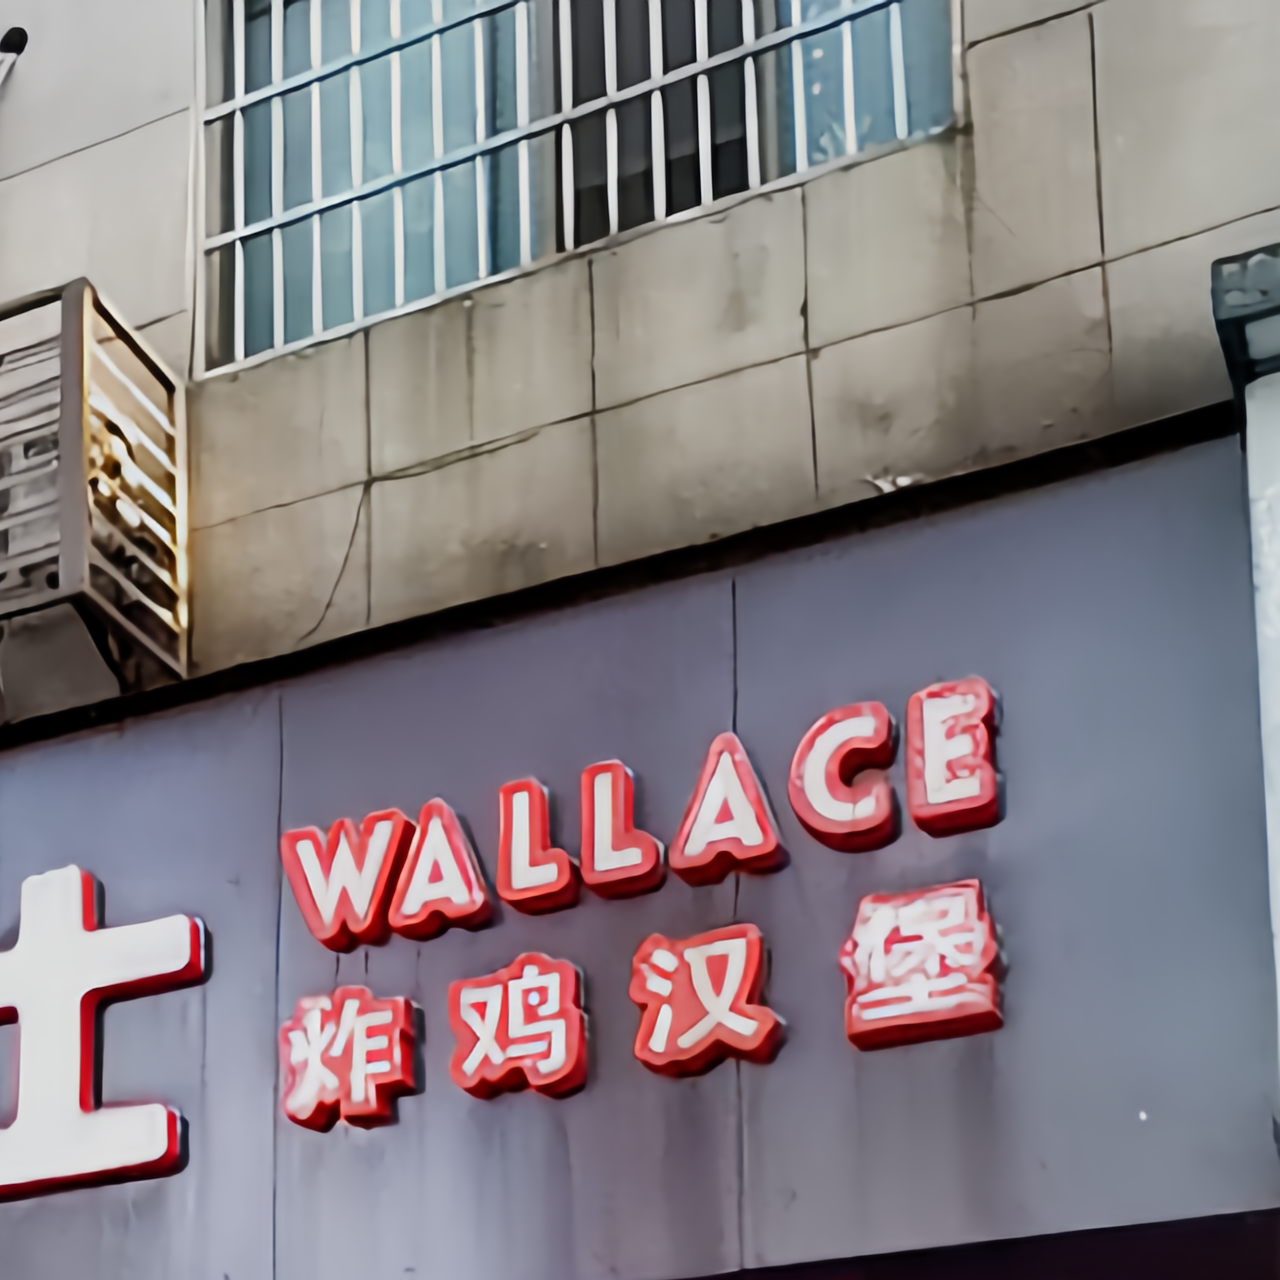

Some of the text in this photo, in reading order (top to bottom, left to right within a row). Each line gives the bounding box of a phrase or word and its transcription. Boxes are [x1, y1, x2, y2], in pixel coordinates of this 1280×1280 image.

[280, 676, 1001, 952] WALLACE
[280, 879, 1004, 1131] 炸鸡汉堡
